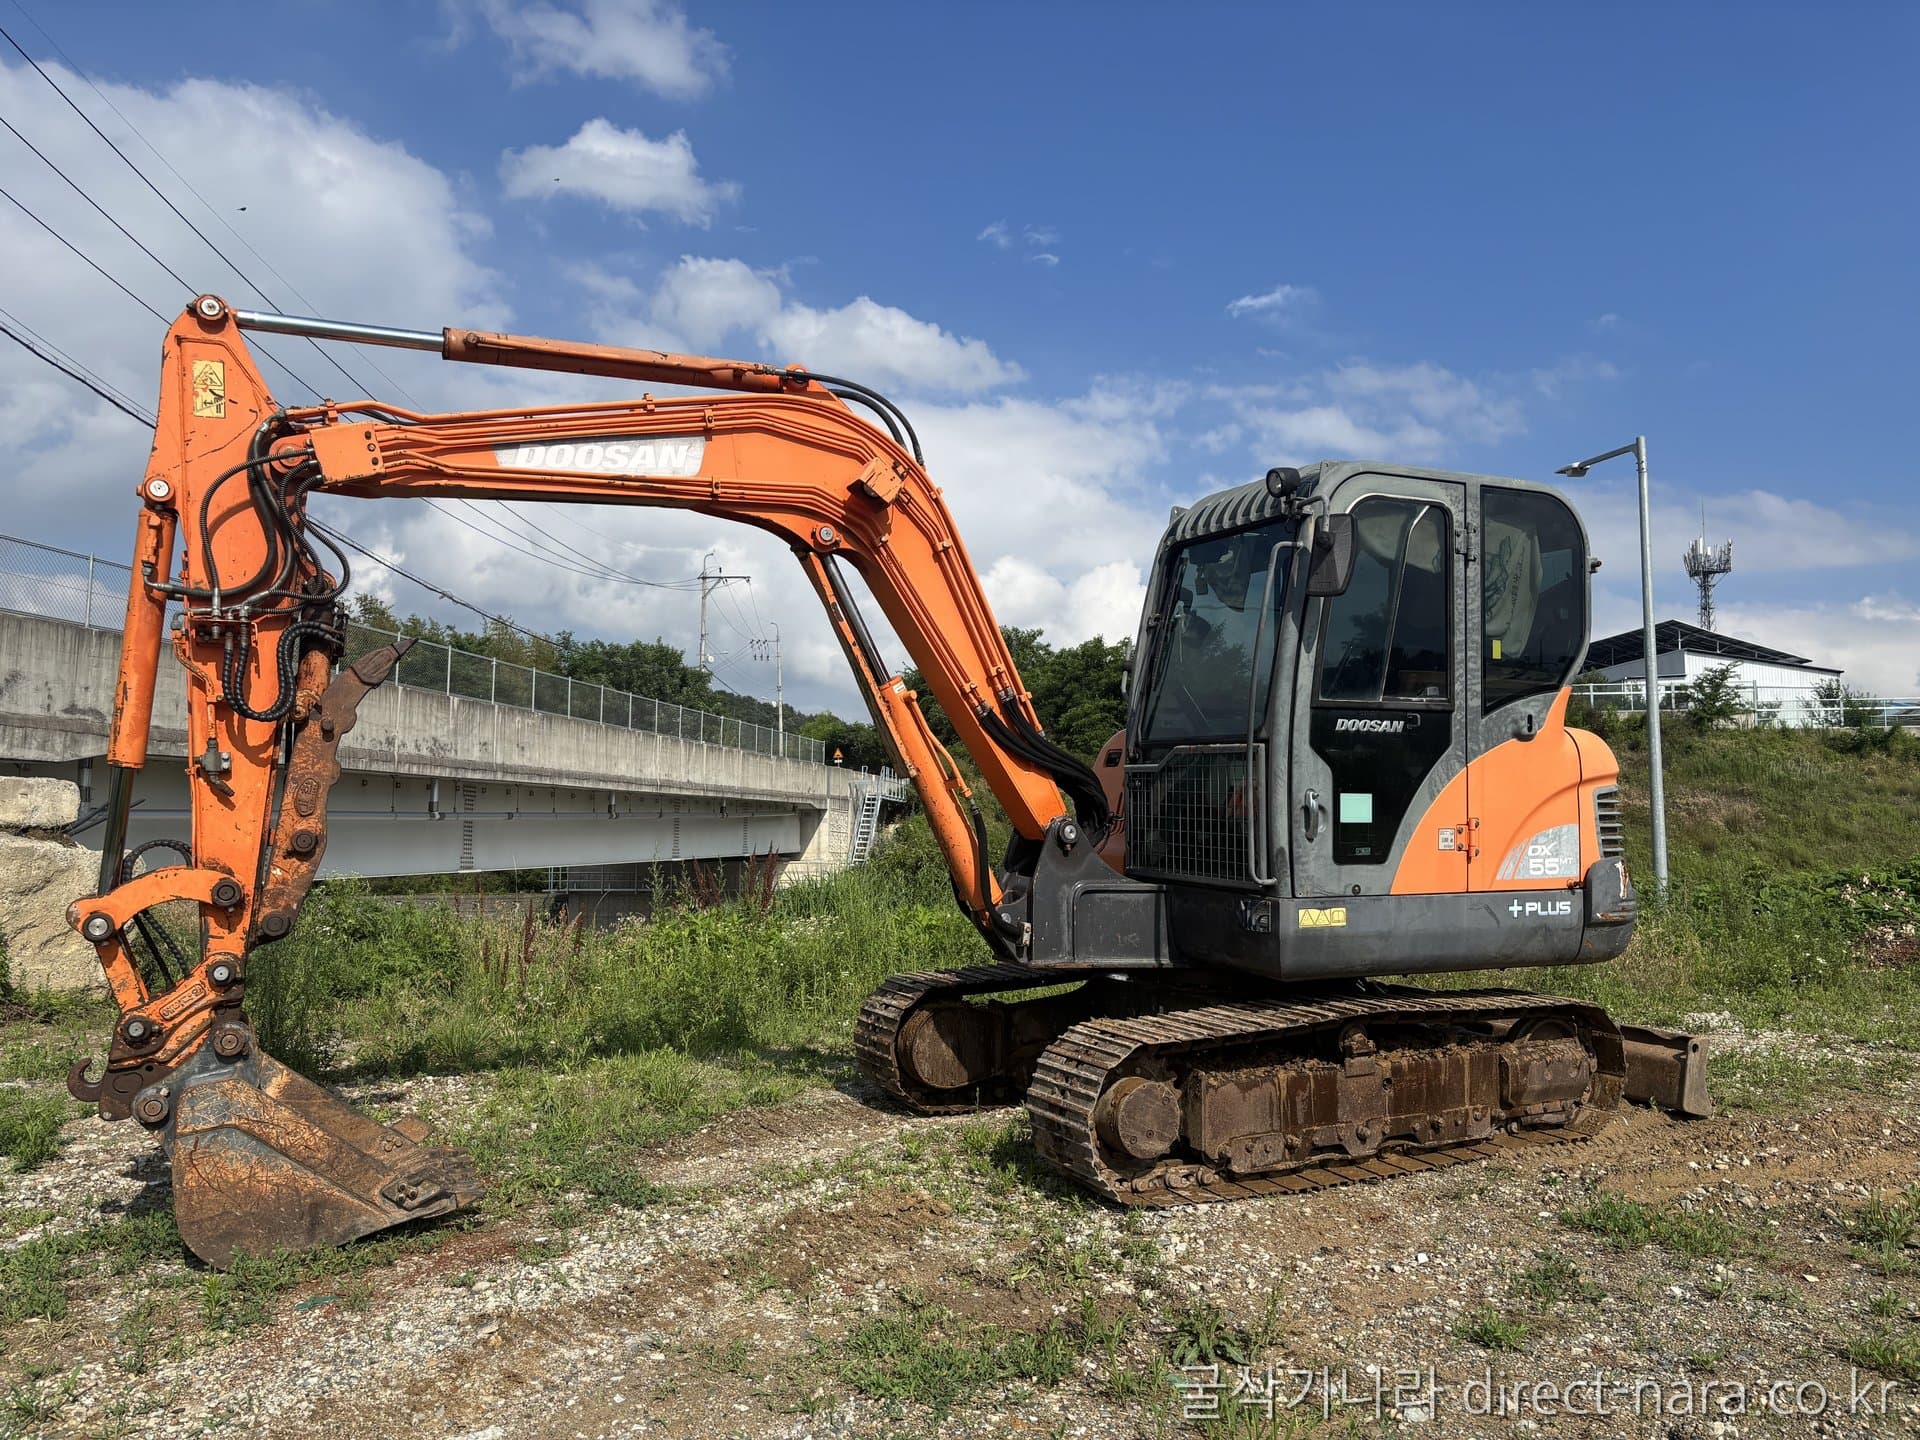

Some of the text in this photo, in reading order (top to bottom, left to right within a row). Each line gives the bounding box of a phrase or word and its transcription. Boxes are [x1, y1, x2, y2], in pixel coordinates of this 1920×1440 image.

[514, 444, 690, 469] DOOSAN
[1336, 718, 1404, 733] DOOSAN
[1528, 842, 1557, 857] DX
